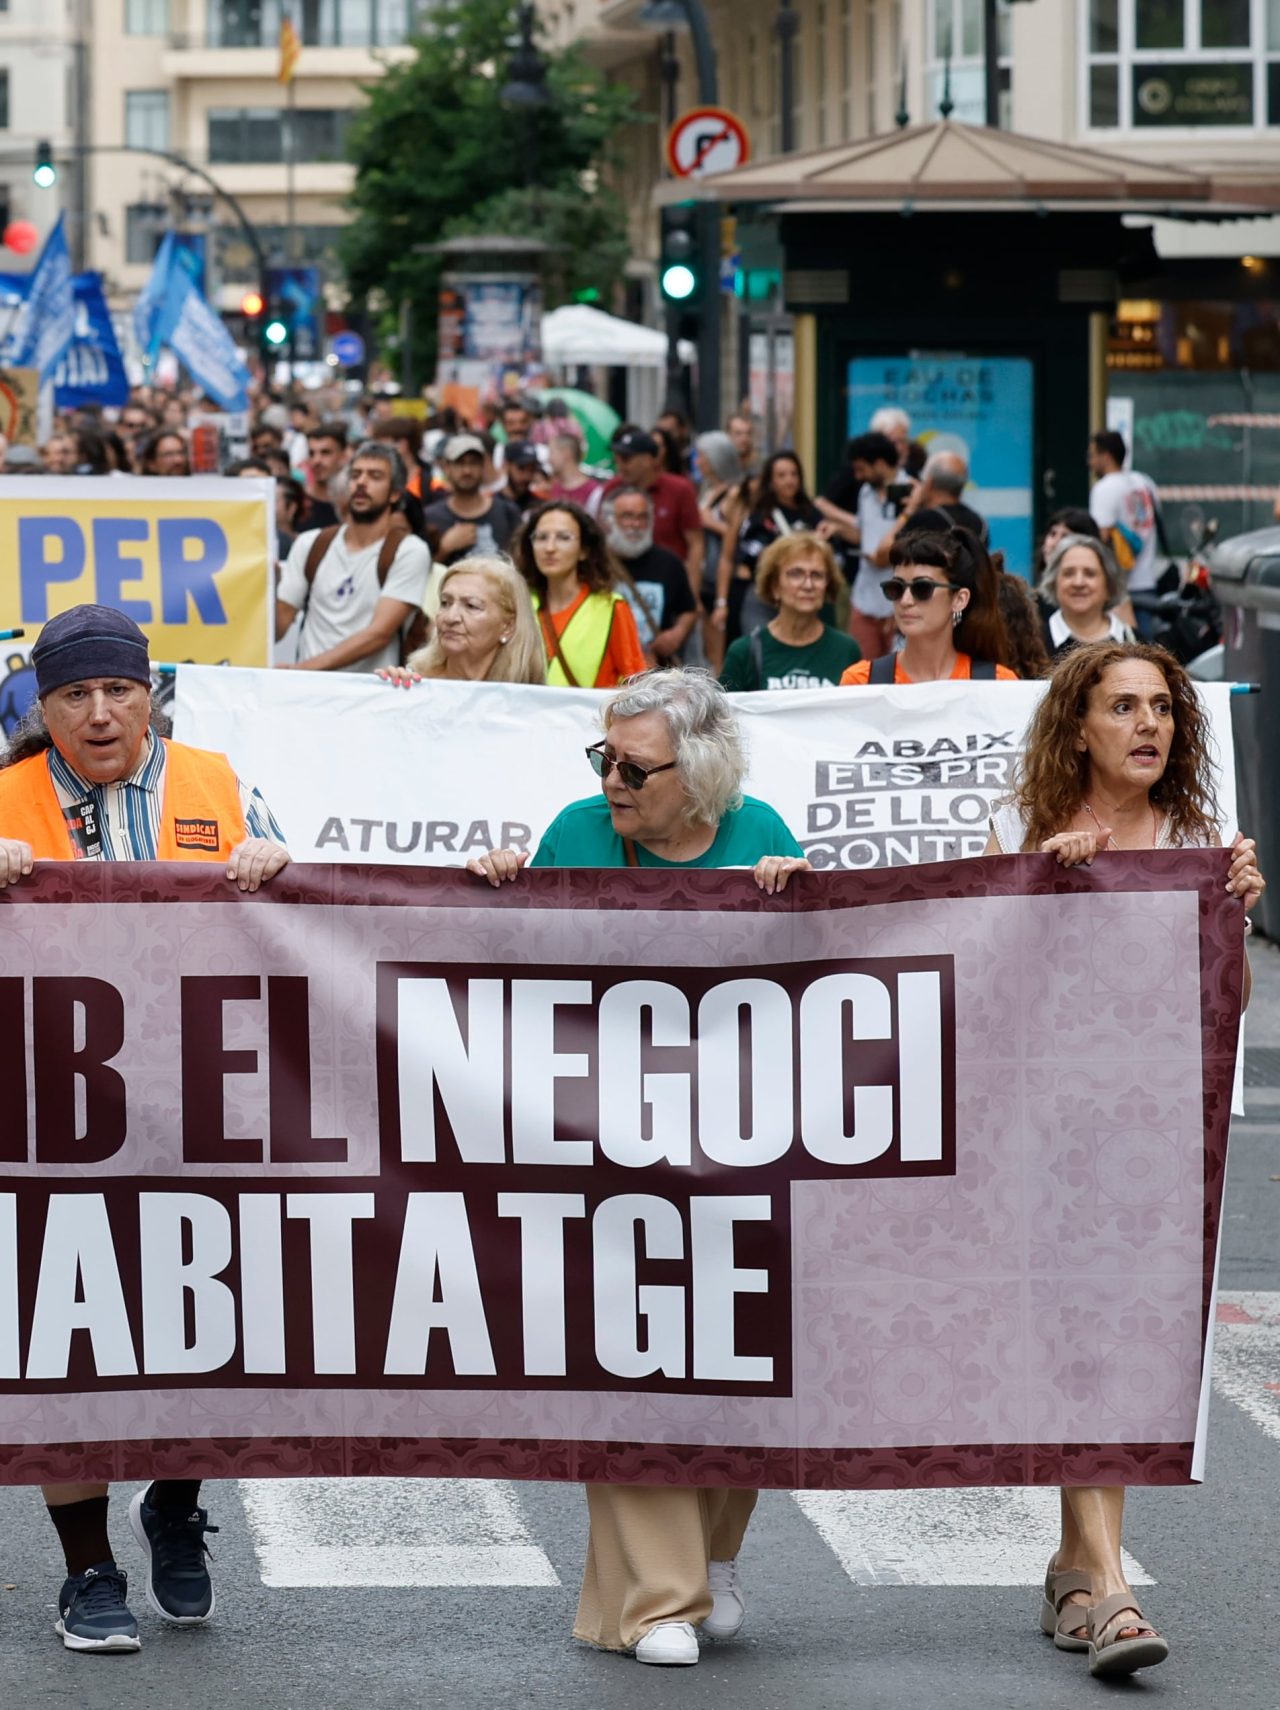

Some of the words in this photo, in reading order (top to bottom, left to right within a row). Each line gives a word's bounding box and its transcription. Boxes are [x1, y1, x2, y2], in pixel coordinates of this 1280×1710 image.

[17, 516, 229, 626] PER
[854, 730, 1024, 759] ABAIX
[827, 763, 925, 791] ELS
[939, 756, 1024, 785] PR
[80, 803, 95, 817] CAP
[806, 797, 876, 834] DE
[890, 793, 990, 826] LLO
[175, 823, 216, 836] SINDICAT
[314, 816, 533, 857] ATURAR
[180, 974, 349, 1164] EL
[397, 970, 943, 1169] NEGOCI
